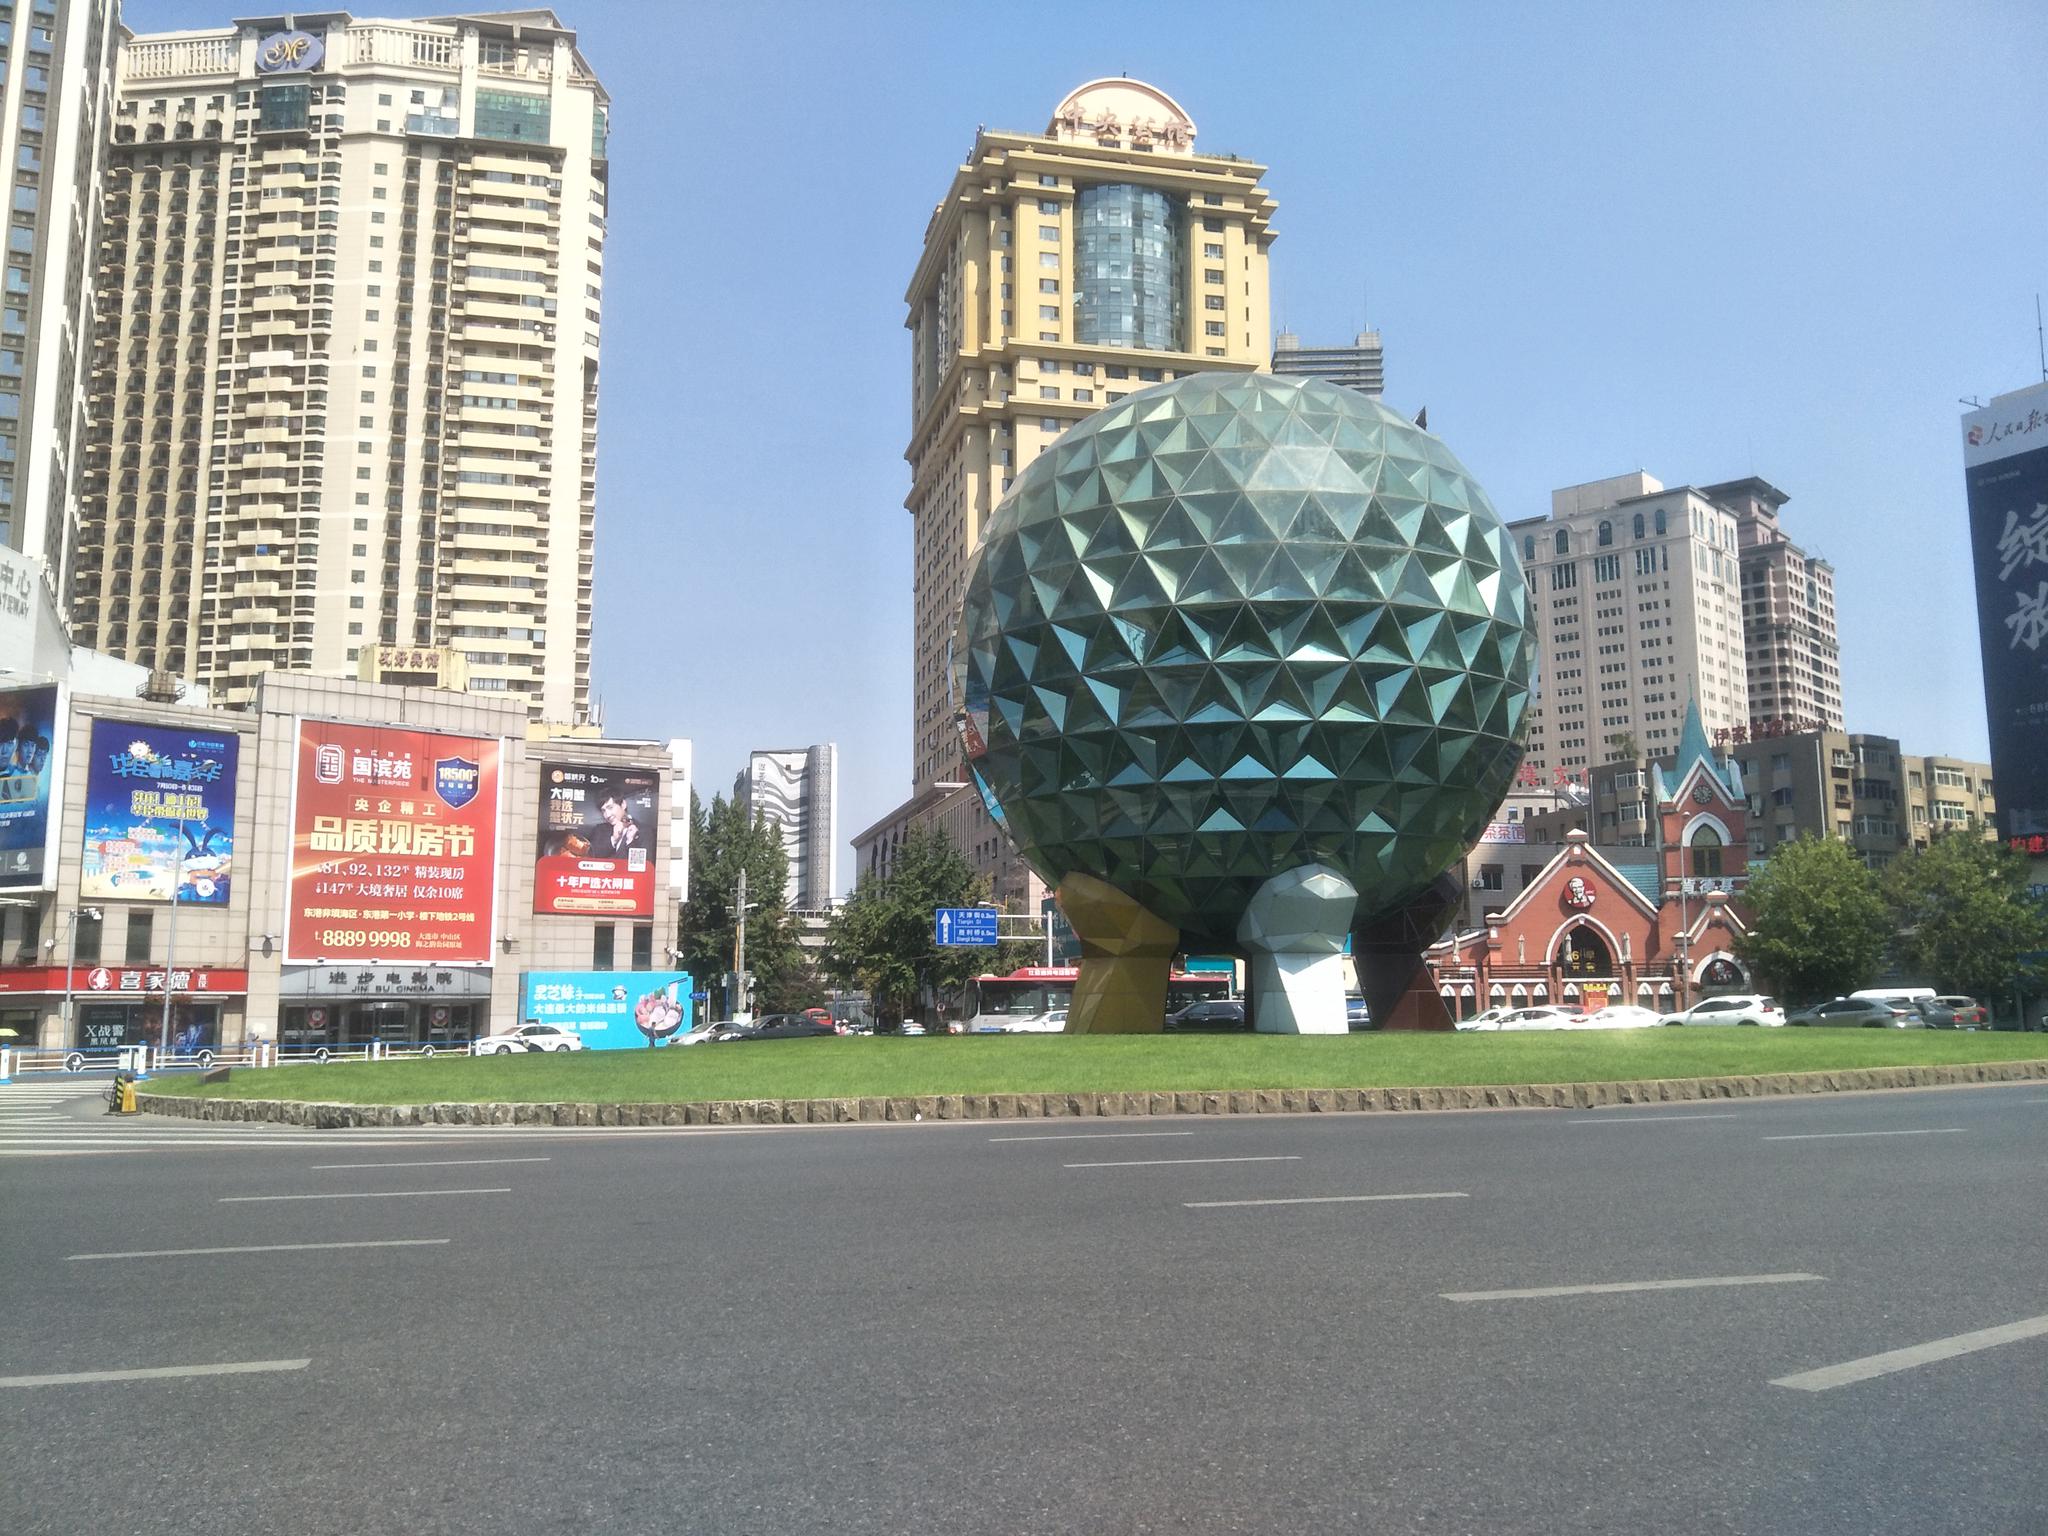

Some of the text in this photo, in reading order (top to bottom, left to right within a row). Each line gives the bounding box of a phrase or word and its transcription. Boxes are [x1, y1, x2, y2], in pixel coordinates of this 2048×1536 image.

[1984, 408, 2048, 446] 人民日报
[353, 757, 413, 780] 国滨苑
[355, 797, 437, 817] 央企精工
[309, 816, 475, 857] 品质现房节
[413, 885, 464, 900] 仅余10席
[322, 929, 411, 948] 8889 9998
[120, 971, 191, 990] 喜家德
[328, 971, 453, 985] 进步电影院
